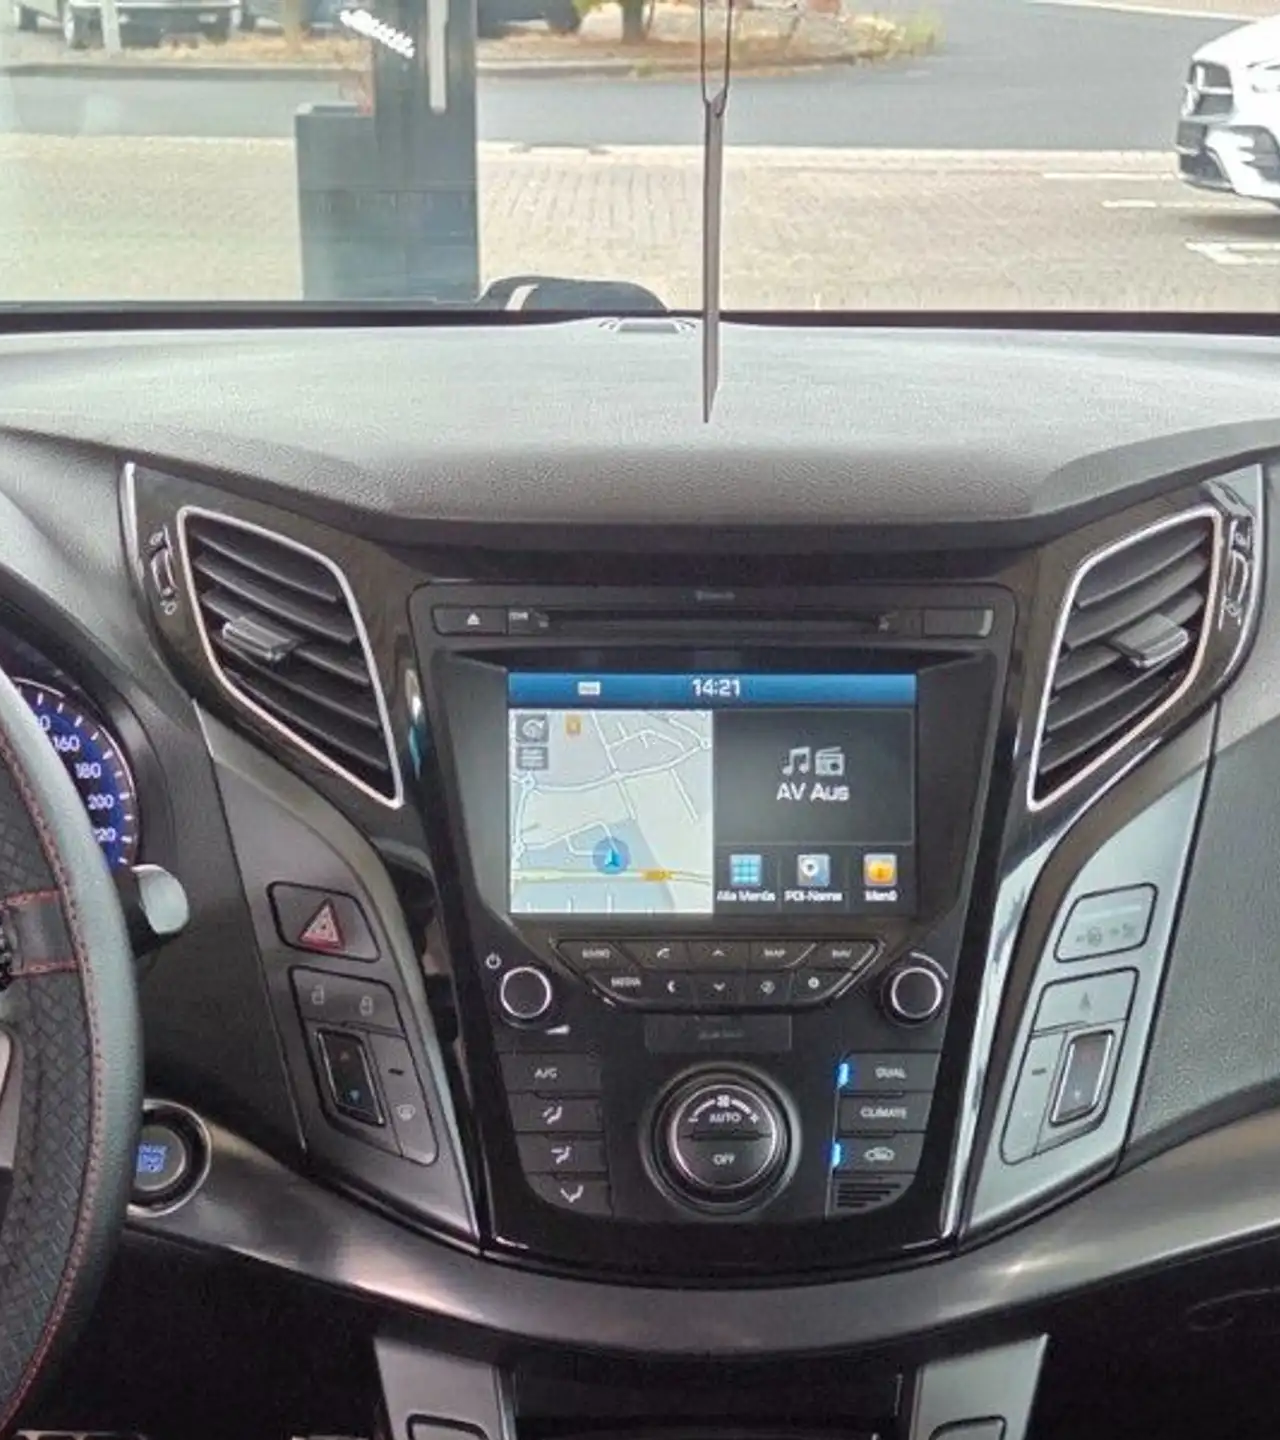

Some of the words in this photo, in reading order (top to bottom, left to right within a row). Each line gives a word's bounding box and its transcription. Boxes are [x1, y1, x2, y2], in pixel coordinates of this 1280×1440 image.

[692, 678, 740, 697] 14:21
[53, 734, 81, 753] 160
[75, 762, 102, 778] 180
[776, 787, 806, 801] AV
[810, 786, 850, 801] Aus
[87, 793, 115, 810] 200
[611, 976, 641, 988] MEDIA
[534, 1067, 558, 1079] A/C
[875, 1067, 906, 1079] DUAL
[709, 1111, 742, 1123] AUTO
[860, 1105, 908, 1119] CLIMATE
[713, 1153, 736, 1165] OFF
